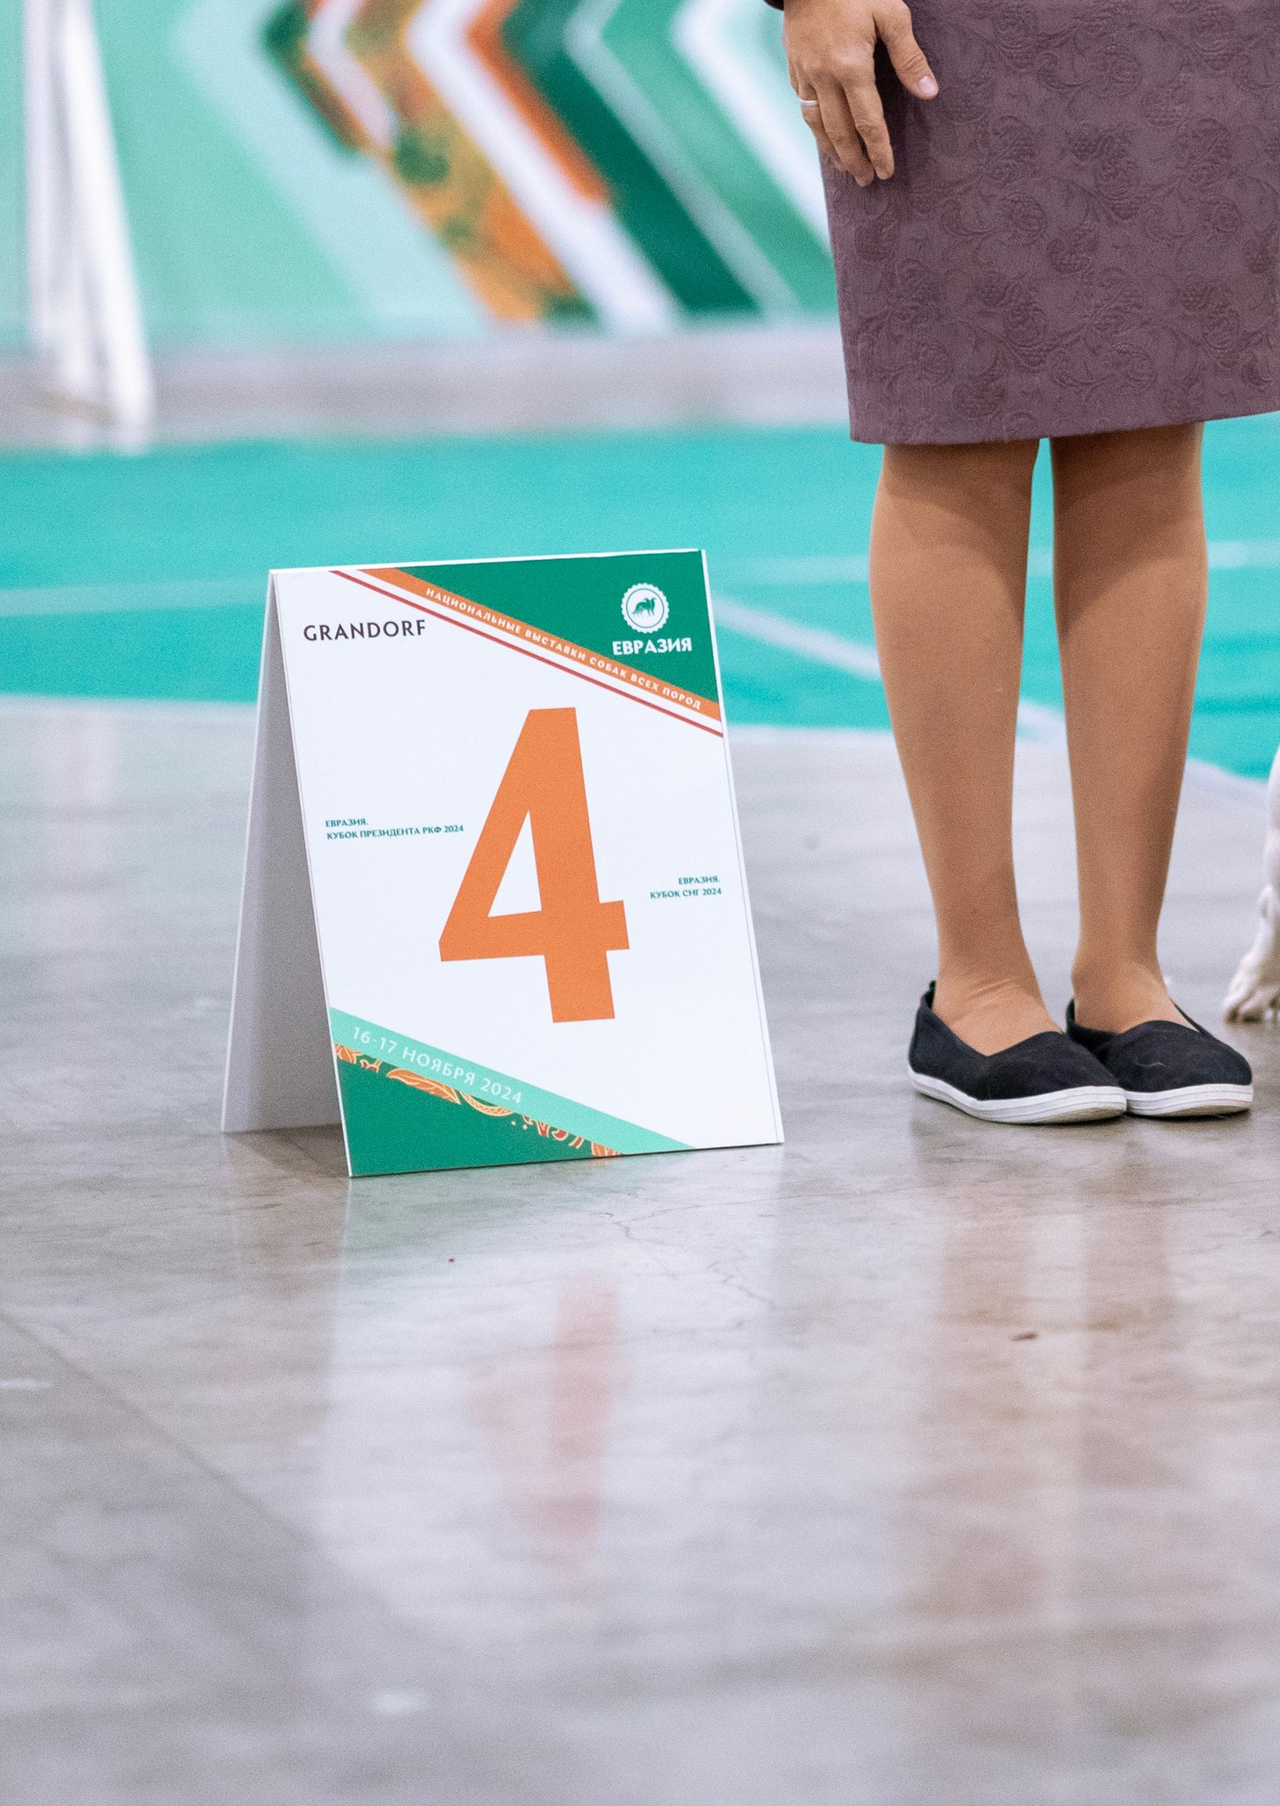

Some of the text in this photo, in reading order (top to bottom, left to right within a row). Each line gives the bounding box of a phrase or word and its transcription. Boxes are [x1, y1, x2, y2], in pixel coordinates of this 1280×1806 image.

[303, 619, 426, 642] GRANDORF
[425, 587, 702, 711] НАЦИОНАЛЬНЫЕ ВЫСТАВКИ СОБАК ВСЕХ ПОРОД
[612, 637, 693, 656] ЕВРАЗИЯ
[325, 817, 369, 828] ЕВРАЗИЯ.
[326, 824, 464, 840] КУБОК ПРЕЗИДЕНТА РКФ 2024
[438, 706, 630, 1024] 4
[650, 887, 722, 899] КУБОК СНГ 2024
[353, 1026, 524, 1105] 16-17 НОЯБРЯ 2024
